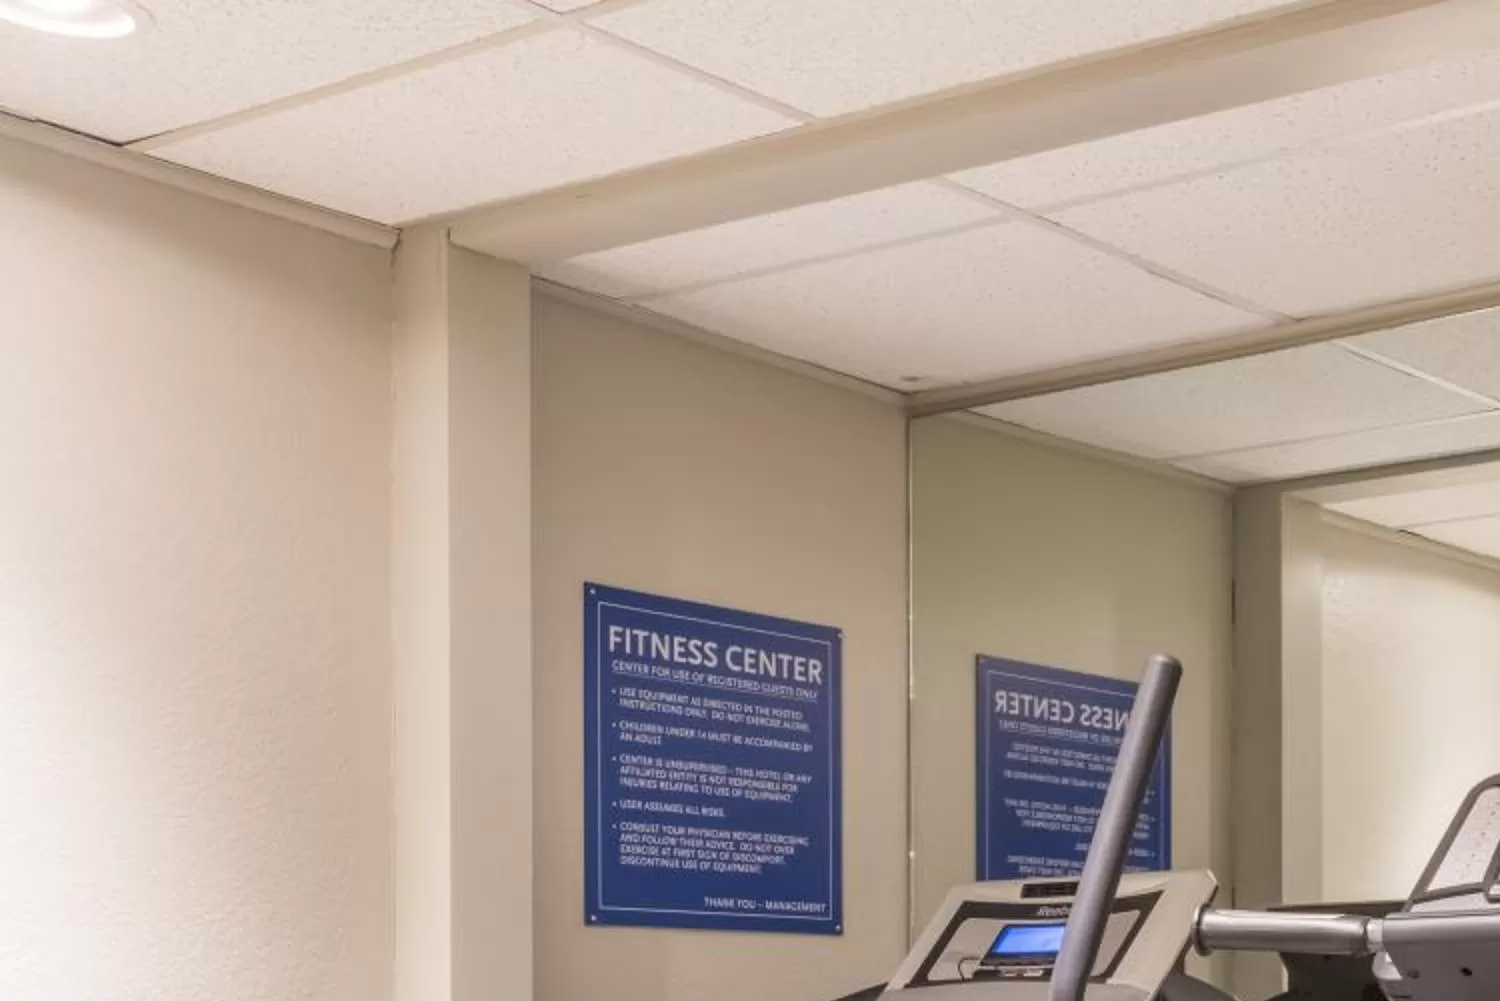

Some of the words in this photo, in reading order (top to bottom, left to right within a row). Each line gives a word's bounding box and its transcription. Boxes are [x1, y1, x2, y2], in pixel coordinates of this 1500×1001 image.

[609, 624, 717, 668] FITNESS
[725, 644, 822, 684] CENTER
[611, 659, 648, 674] CENTER
[651, 665, 669, 677] FOR
[671, 668, 690, 680] USE
[691, 671, 704, 682] OF
[707, 674, 759, 690] REGISTERED
[795, 687, 817, 699] ONLY
[703, 897, 734, 908] THANK
[736, 899, 755, 909] YOU
[765, 900, 826, 912] MANAGEMENT
